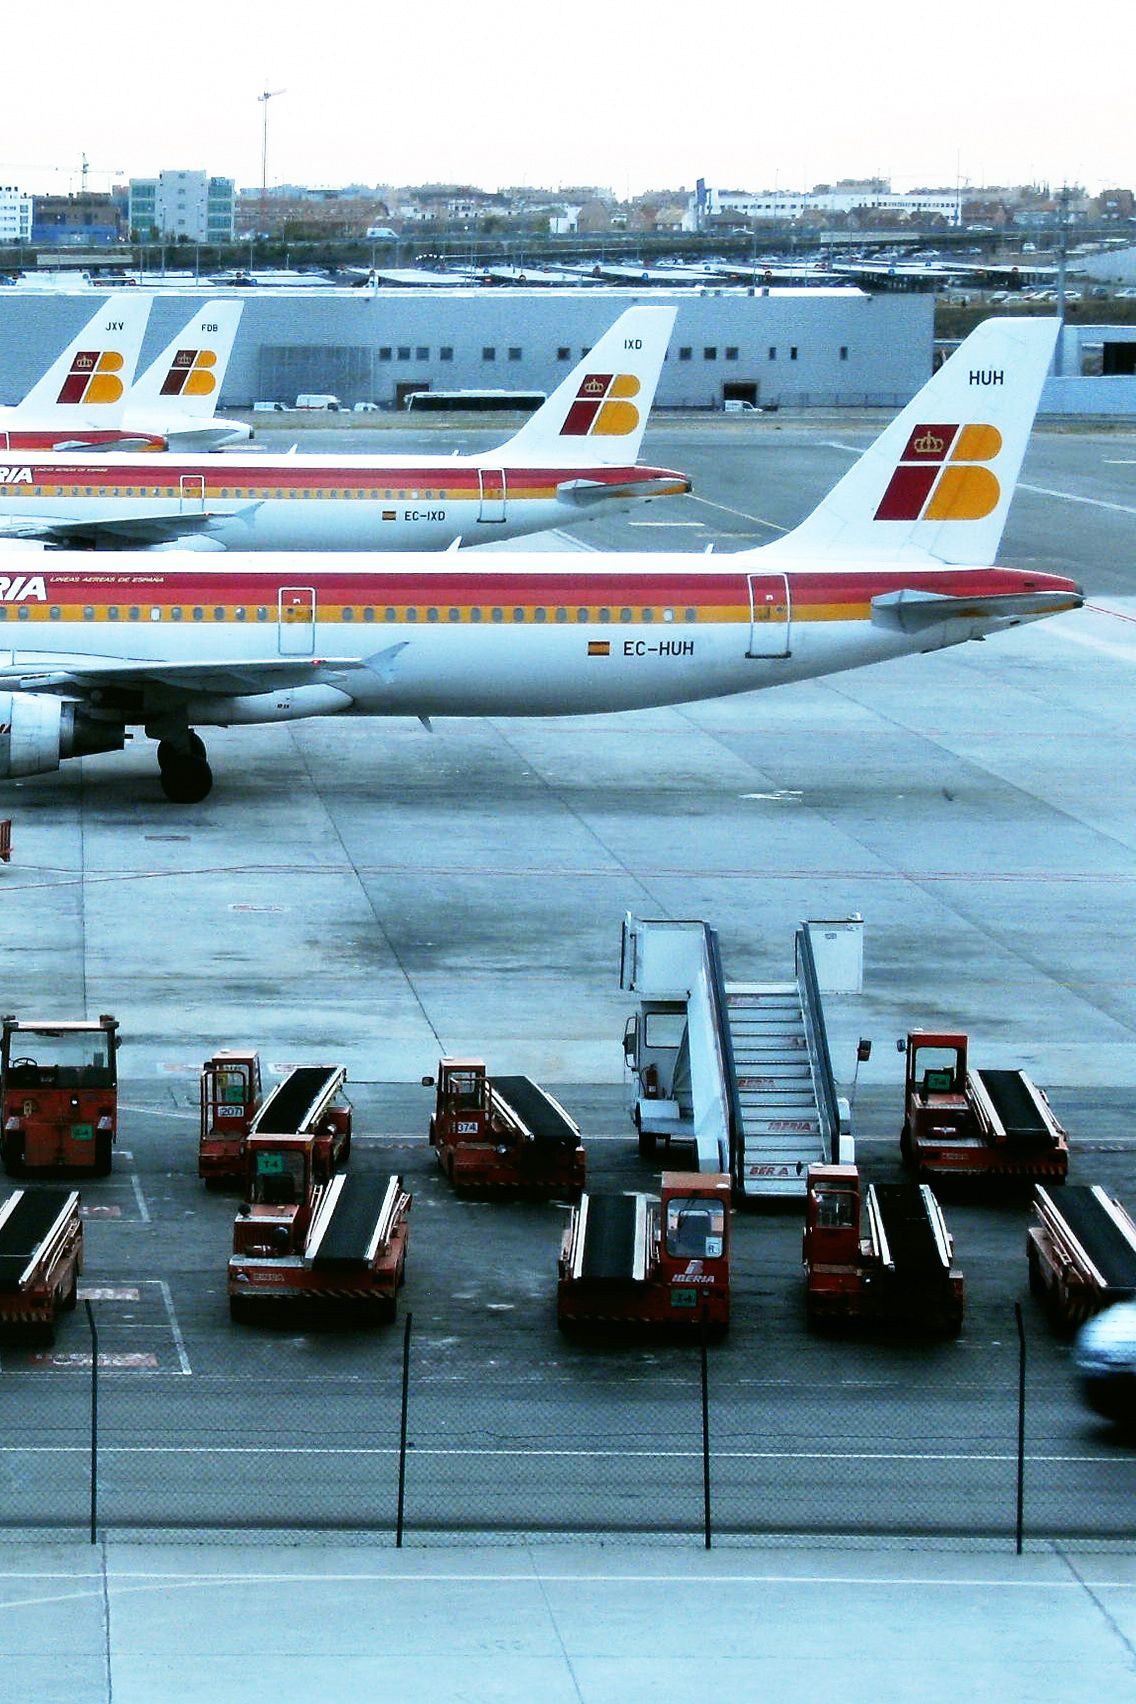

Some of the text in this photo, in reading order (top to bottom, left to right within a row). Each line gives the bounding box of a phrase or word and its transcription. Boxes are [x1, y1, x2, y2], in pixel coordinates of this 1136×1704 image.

[105, 322, 124, 331] JXV
[624, 340, 642, 349] IXD
[969, 370, 1004, 385] HUH
[405, 511, 445, 521] EC-IXD
[623, 641, 694, 656] EC-HUH
[671, 1273, 715, 1283] IBERIA
